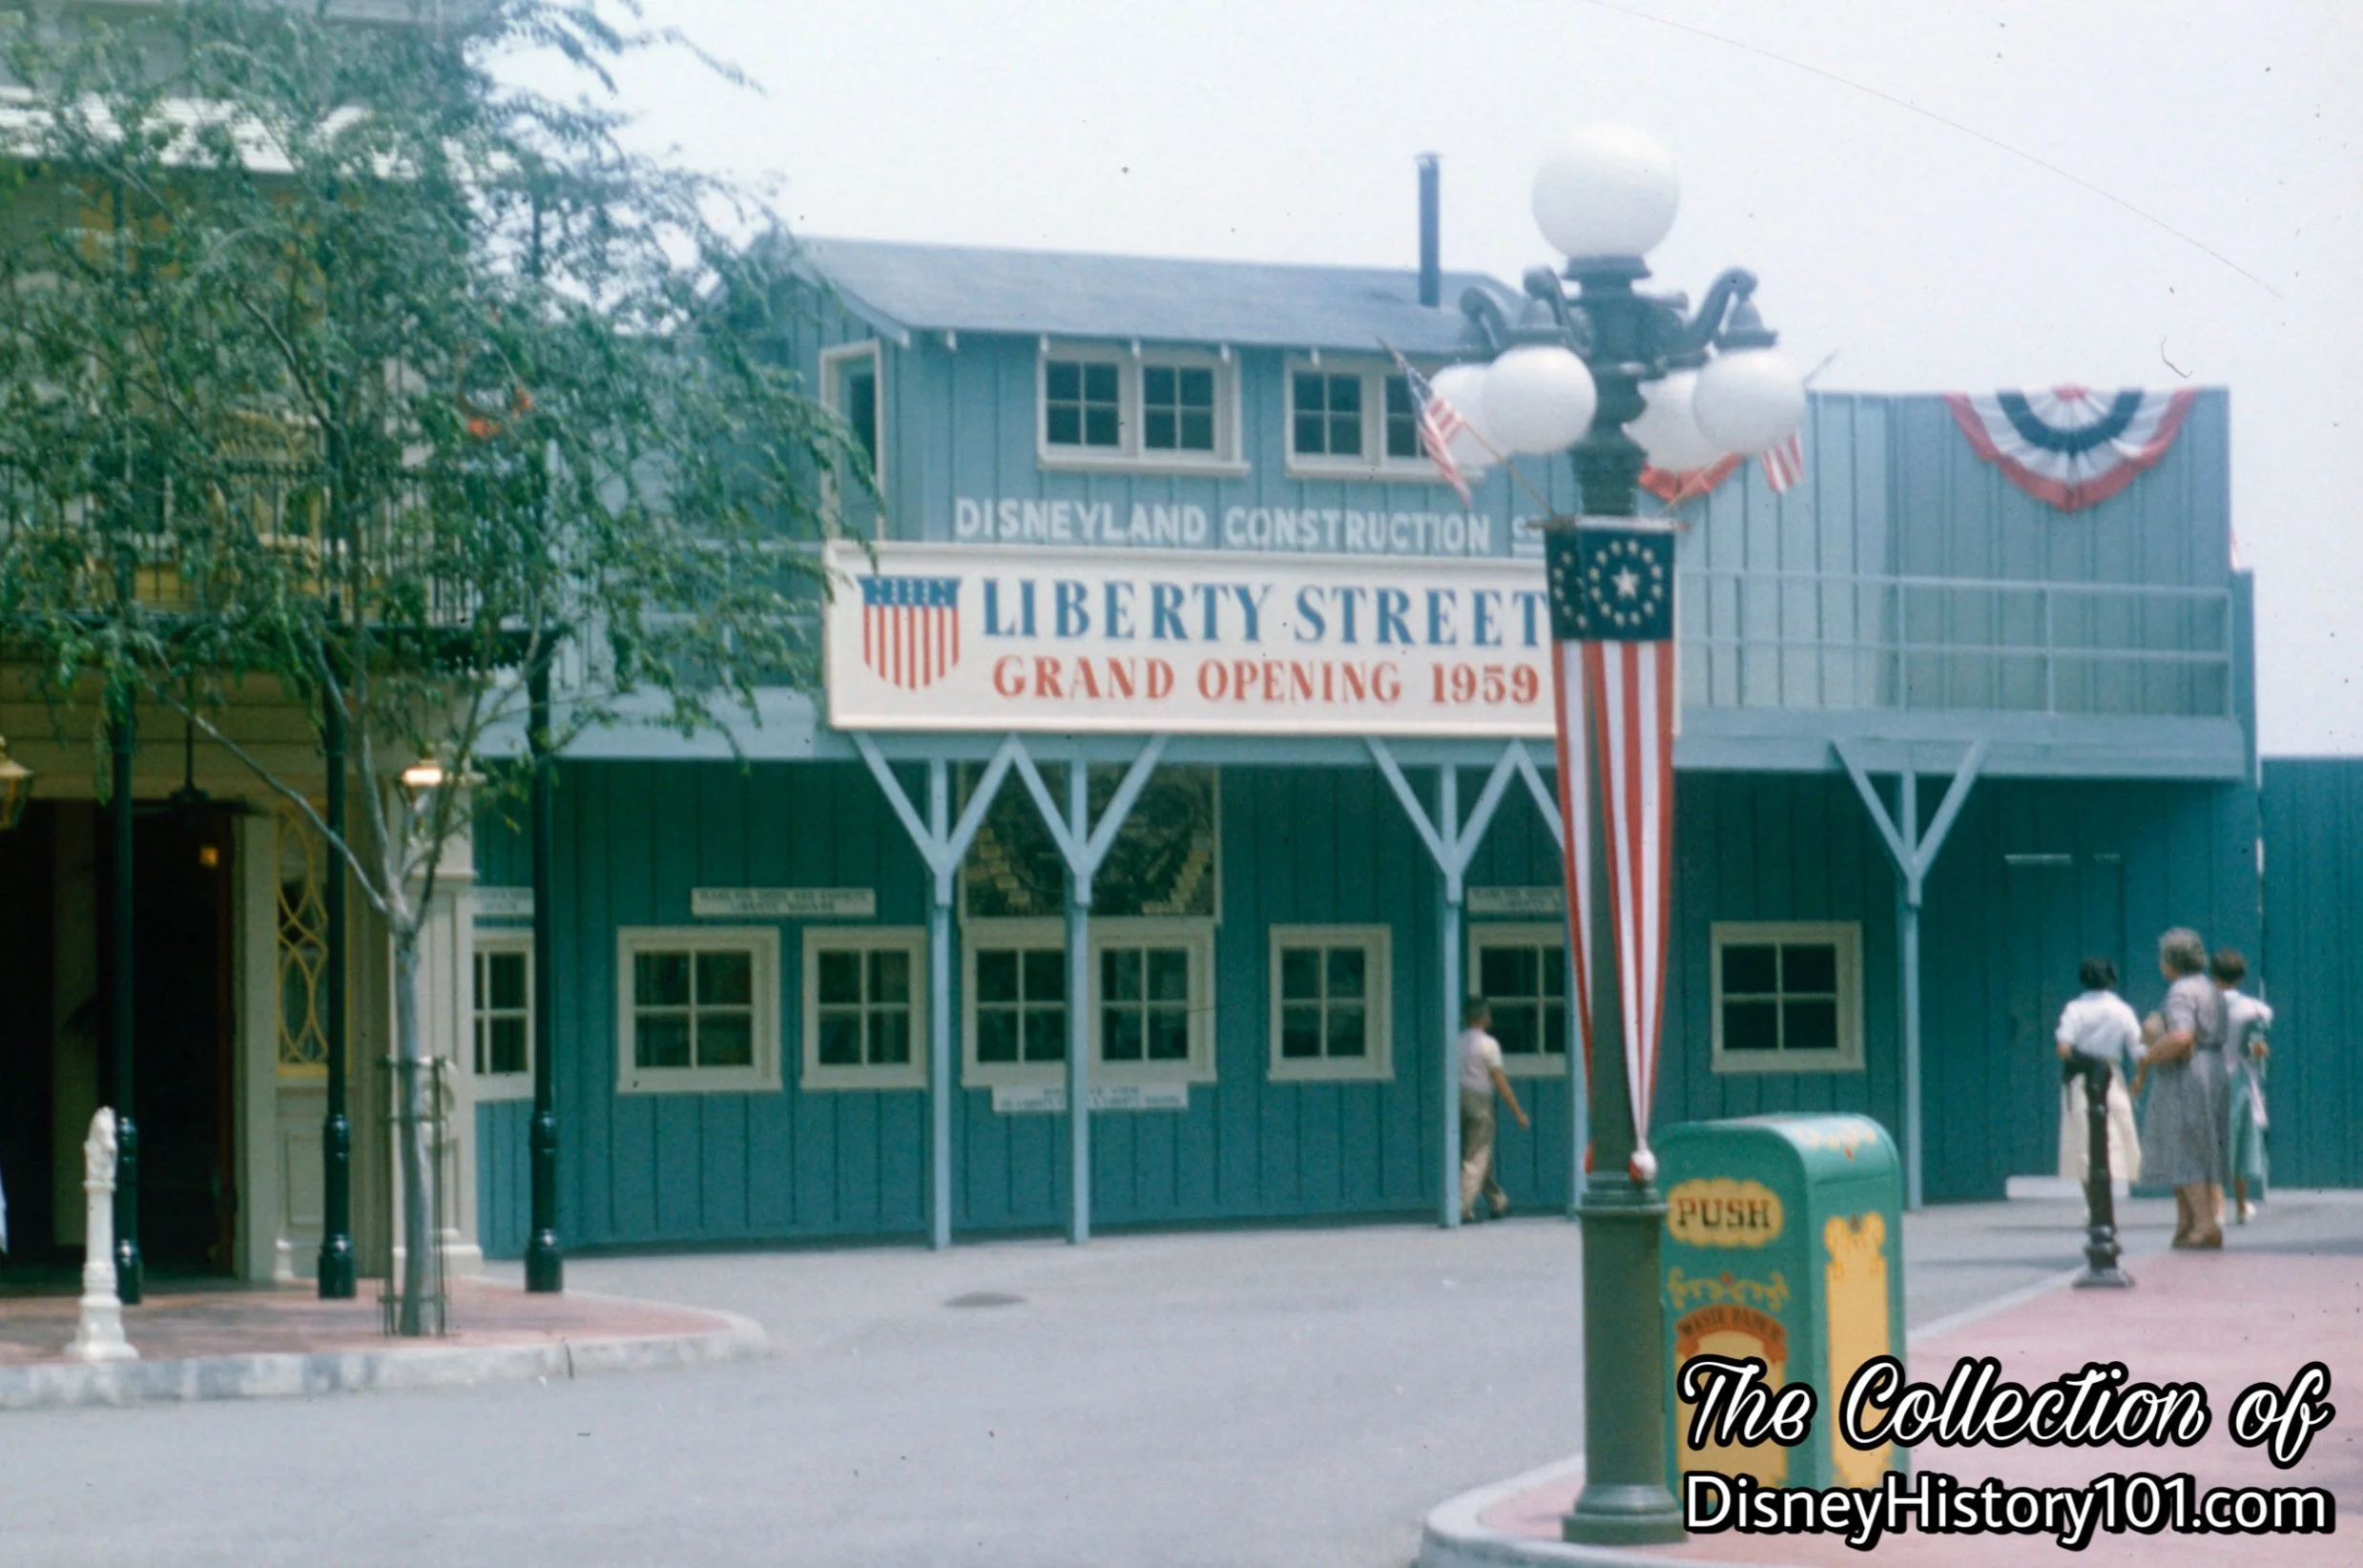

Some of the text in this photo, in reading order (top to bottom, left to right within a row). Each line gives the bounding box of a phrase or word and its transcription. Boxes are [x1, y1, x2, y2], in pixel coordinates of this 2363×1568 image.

[956, 499, 1206, 544] DISNEYLAND
[1225, 506, 1489, 551] CONSTRUCTION
[983, 577, 1549, 648] LIBERTY STREET
[992, 655, 1540, 705] GRAND OPENING 1959
[1676, 1199, 1771, 1228] PUSH
